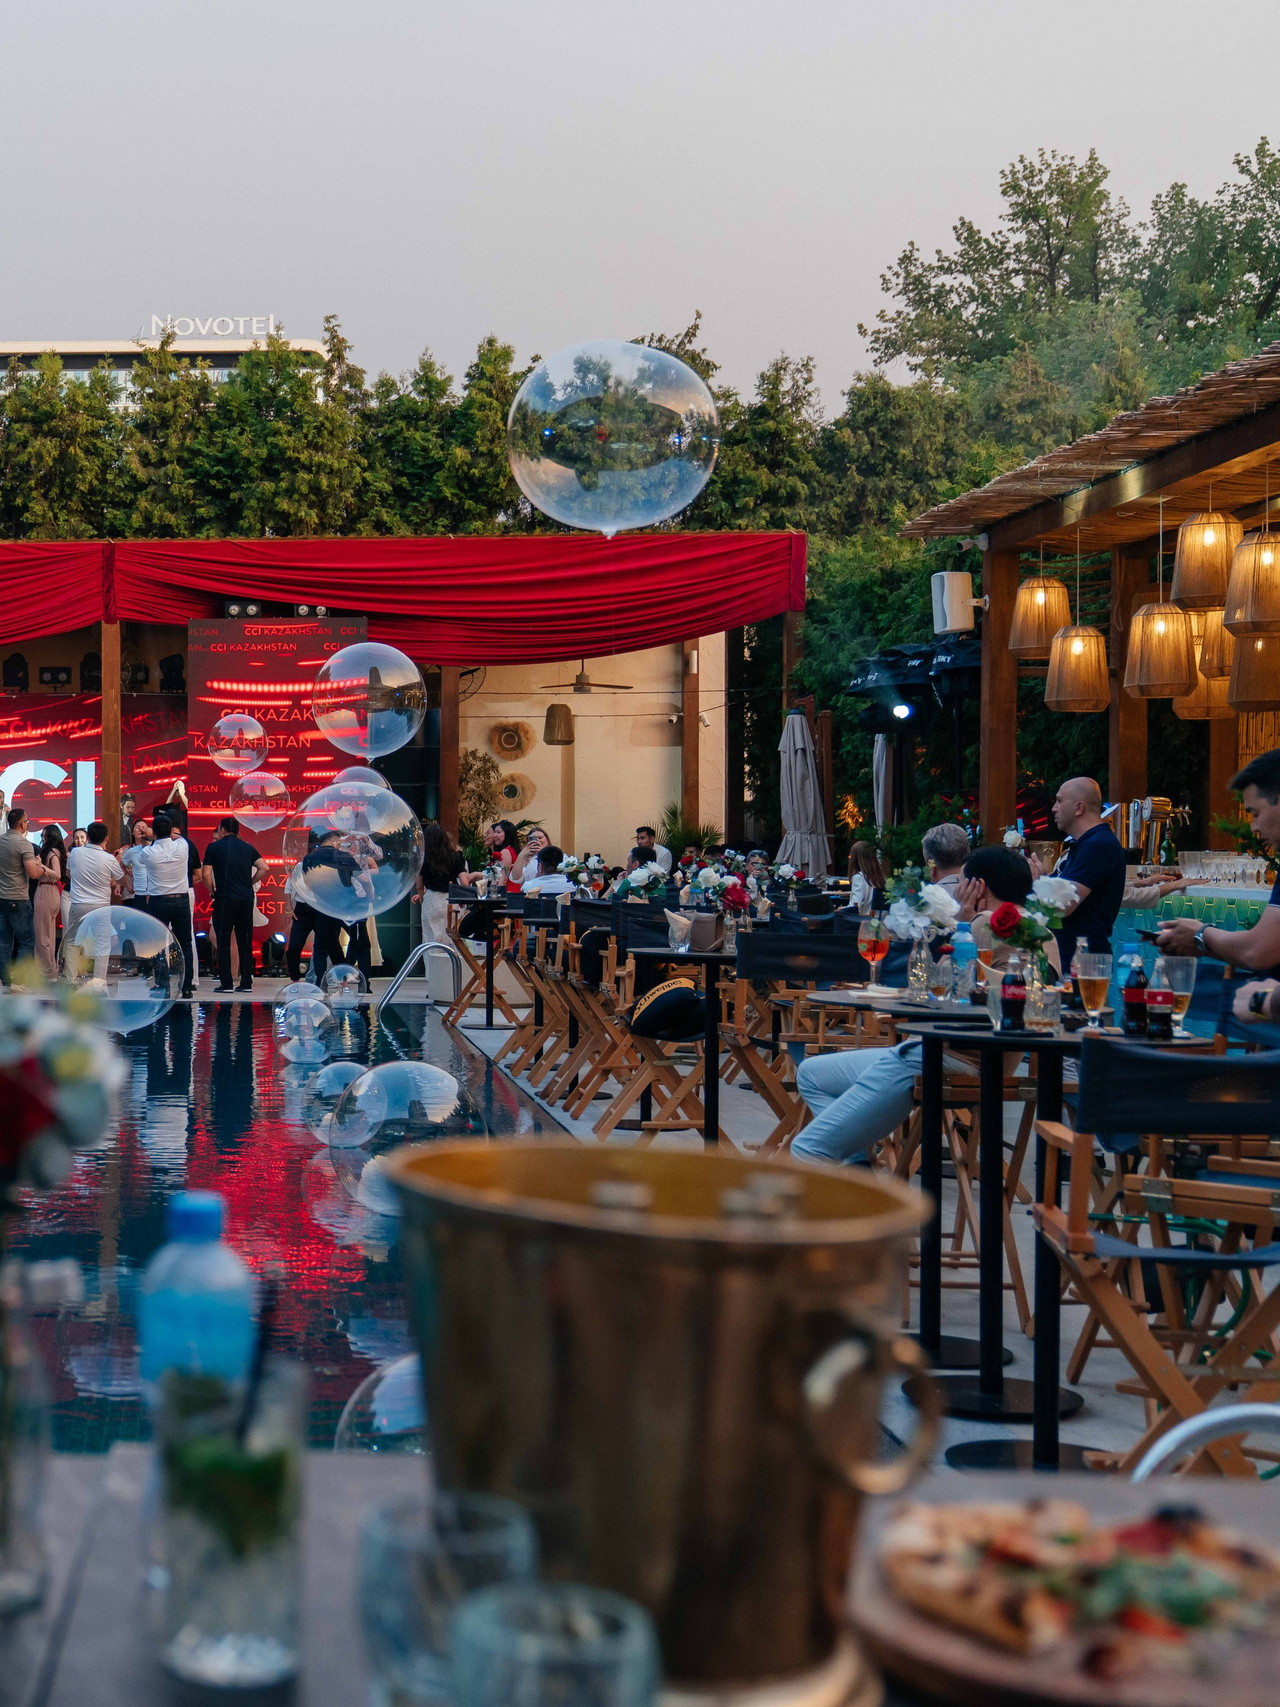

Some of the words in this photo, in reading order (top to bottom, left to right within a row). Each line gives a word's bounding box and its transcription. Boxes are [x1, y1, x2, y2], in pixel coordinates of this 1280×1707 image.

[151, 314, 285, 336] NOVOTEL
[244, 627, 261, 636] CCI
[264, 627, 332, 636] KAZAKHSTAN
[340, 627, 357, 636] CCI
[210, 643, 227, 652] CCI
[229, 643, 297, 651] KAZAKHSTAN
[323, 642, 340, 651] CCI
[221, 708, 249, 723] CCI
[194, 735, 311, 749] KAZAKHSTAN
[210, 800, 226, 808] CCI
[635, 980, 682, 1015] Schweppes
